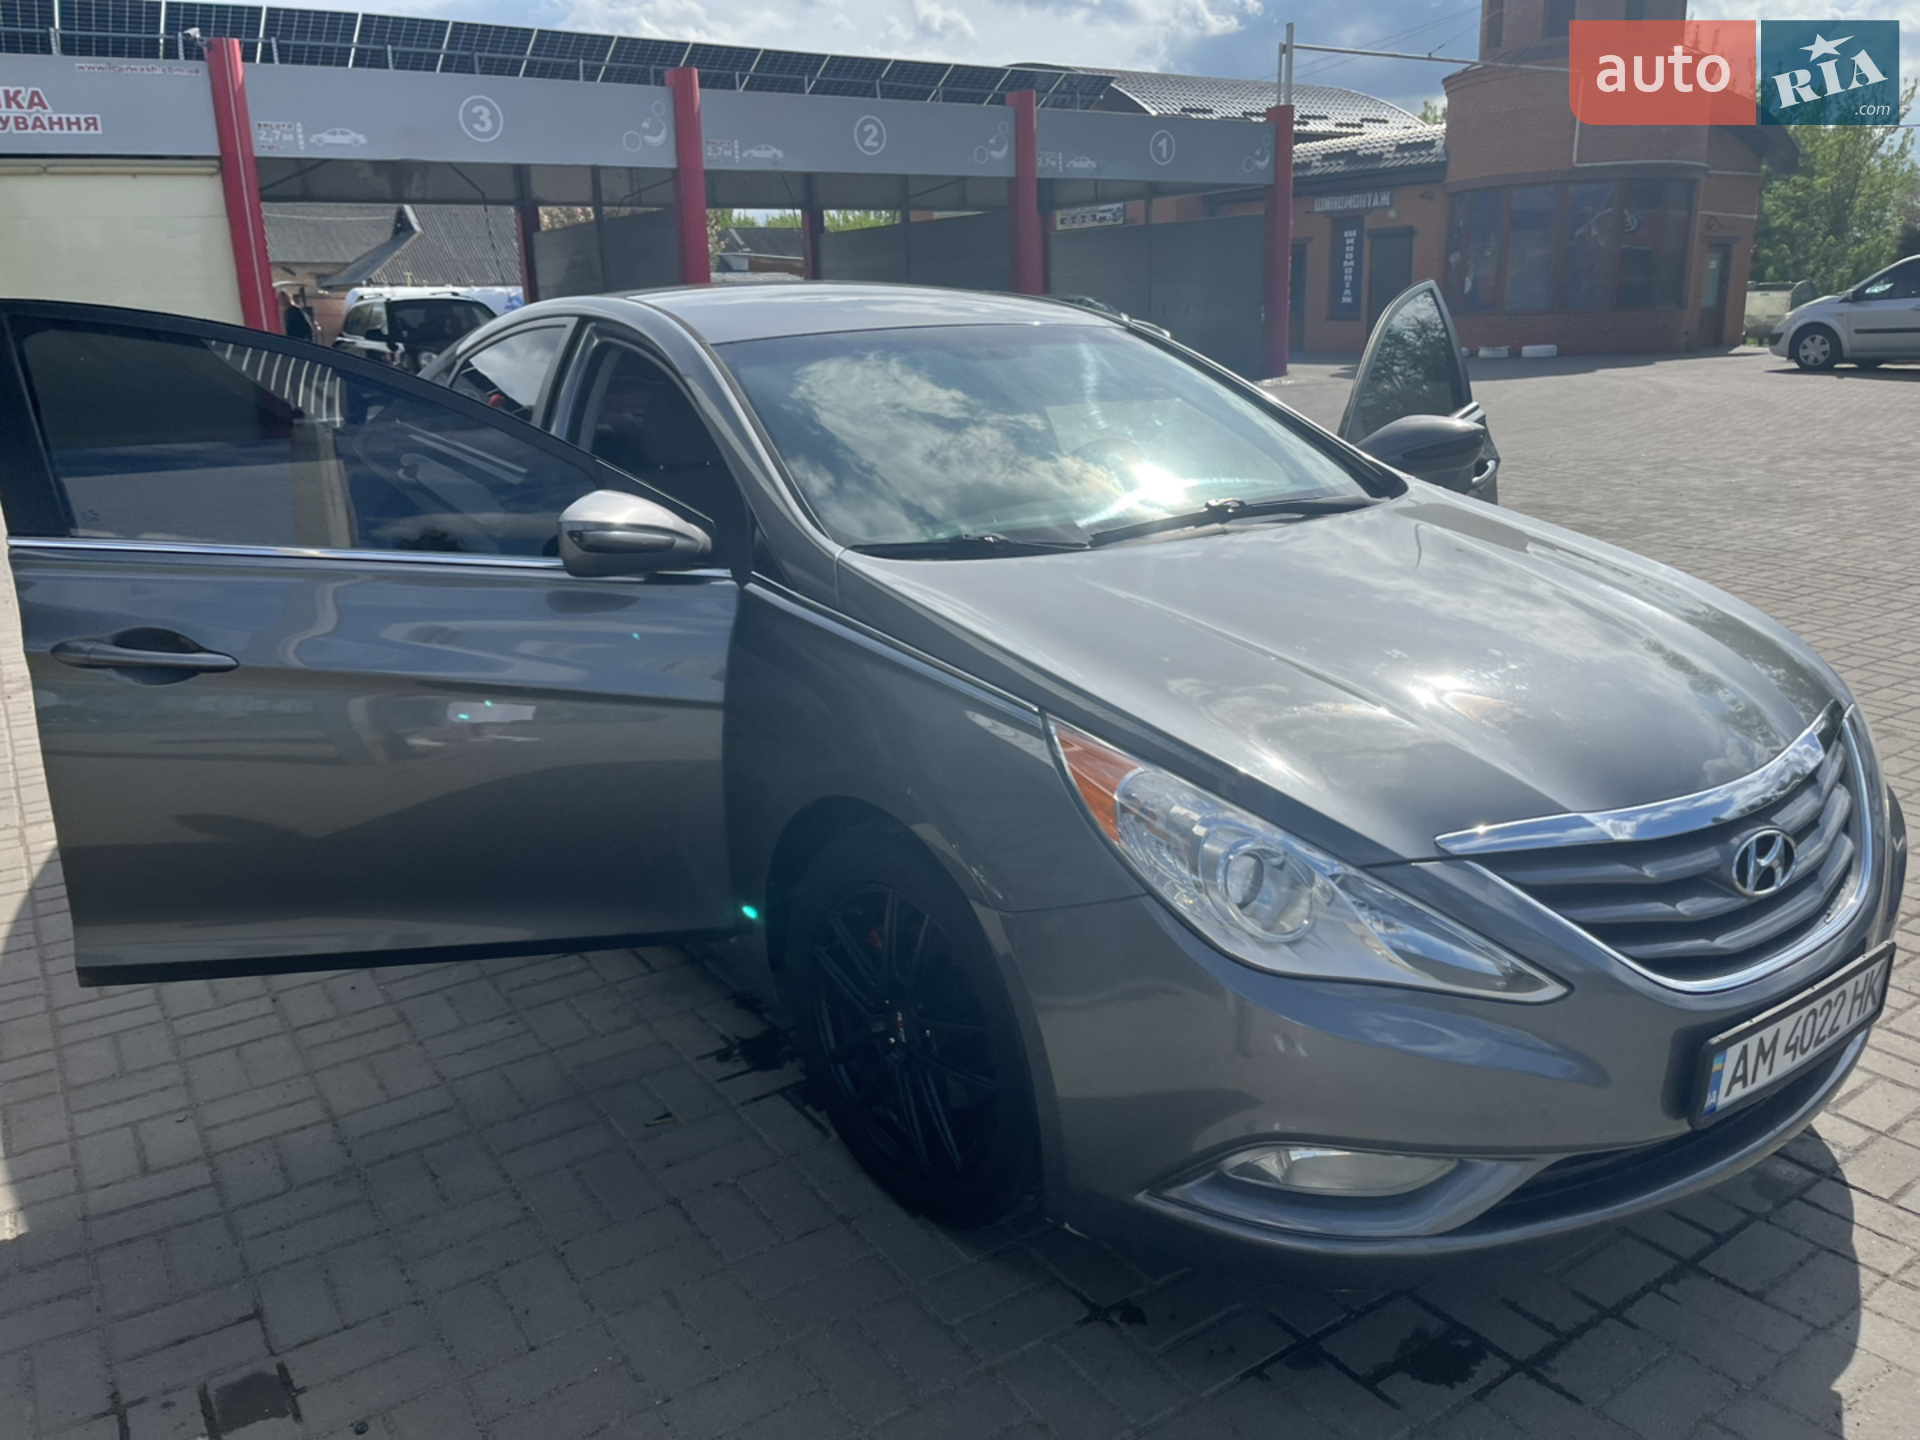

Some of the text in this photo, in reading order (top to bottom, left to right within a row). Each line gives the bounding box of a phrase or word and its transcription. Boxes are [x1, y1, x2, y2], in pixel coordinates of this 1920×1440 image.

[0, 89, 49, 110] КА
[471, 105, 493, 132] 3
[863, 123, 879, 147] 2
[1157, 137, 1168, 158] 1
[1314, 191, 1391, 212] ШИНОМОНТАЖ
[1341, 229, 1357, 303] ШИНОМОНТАЖ
[1724, 961, 1886, 1098] AM 4022 HK
